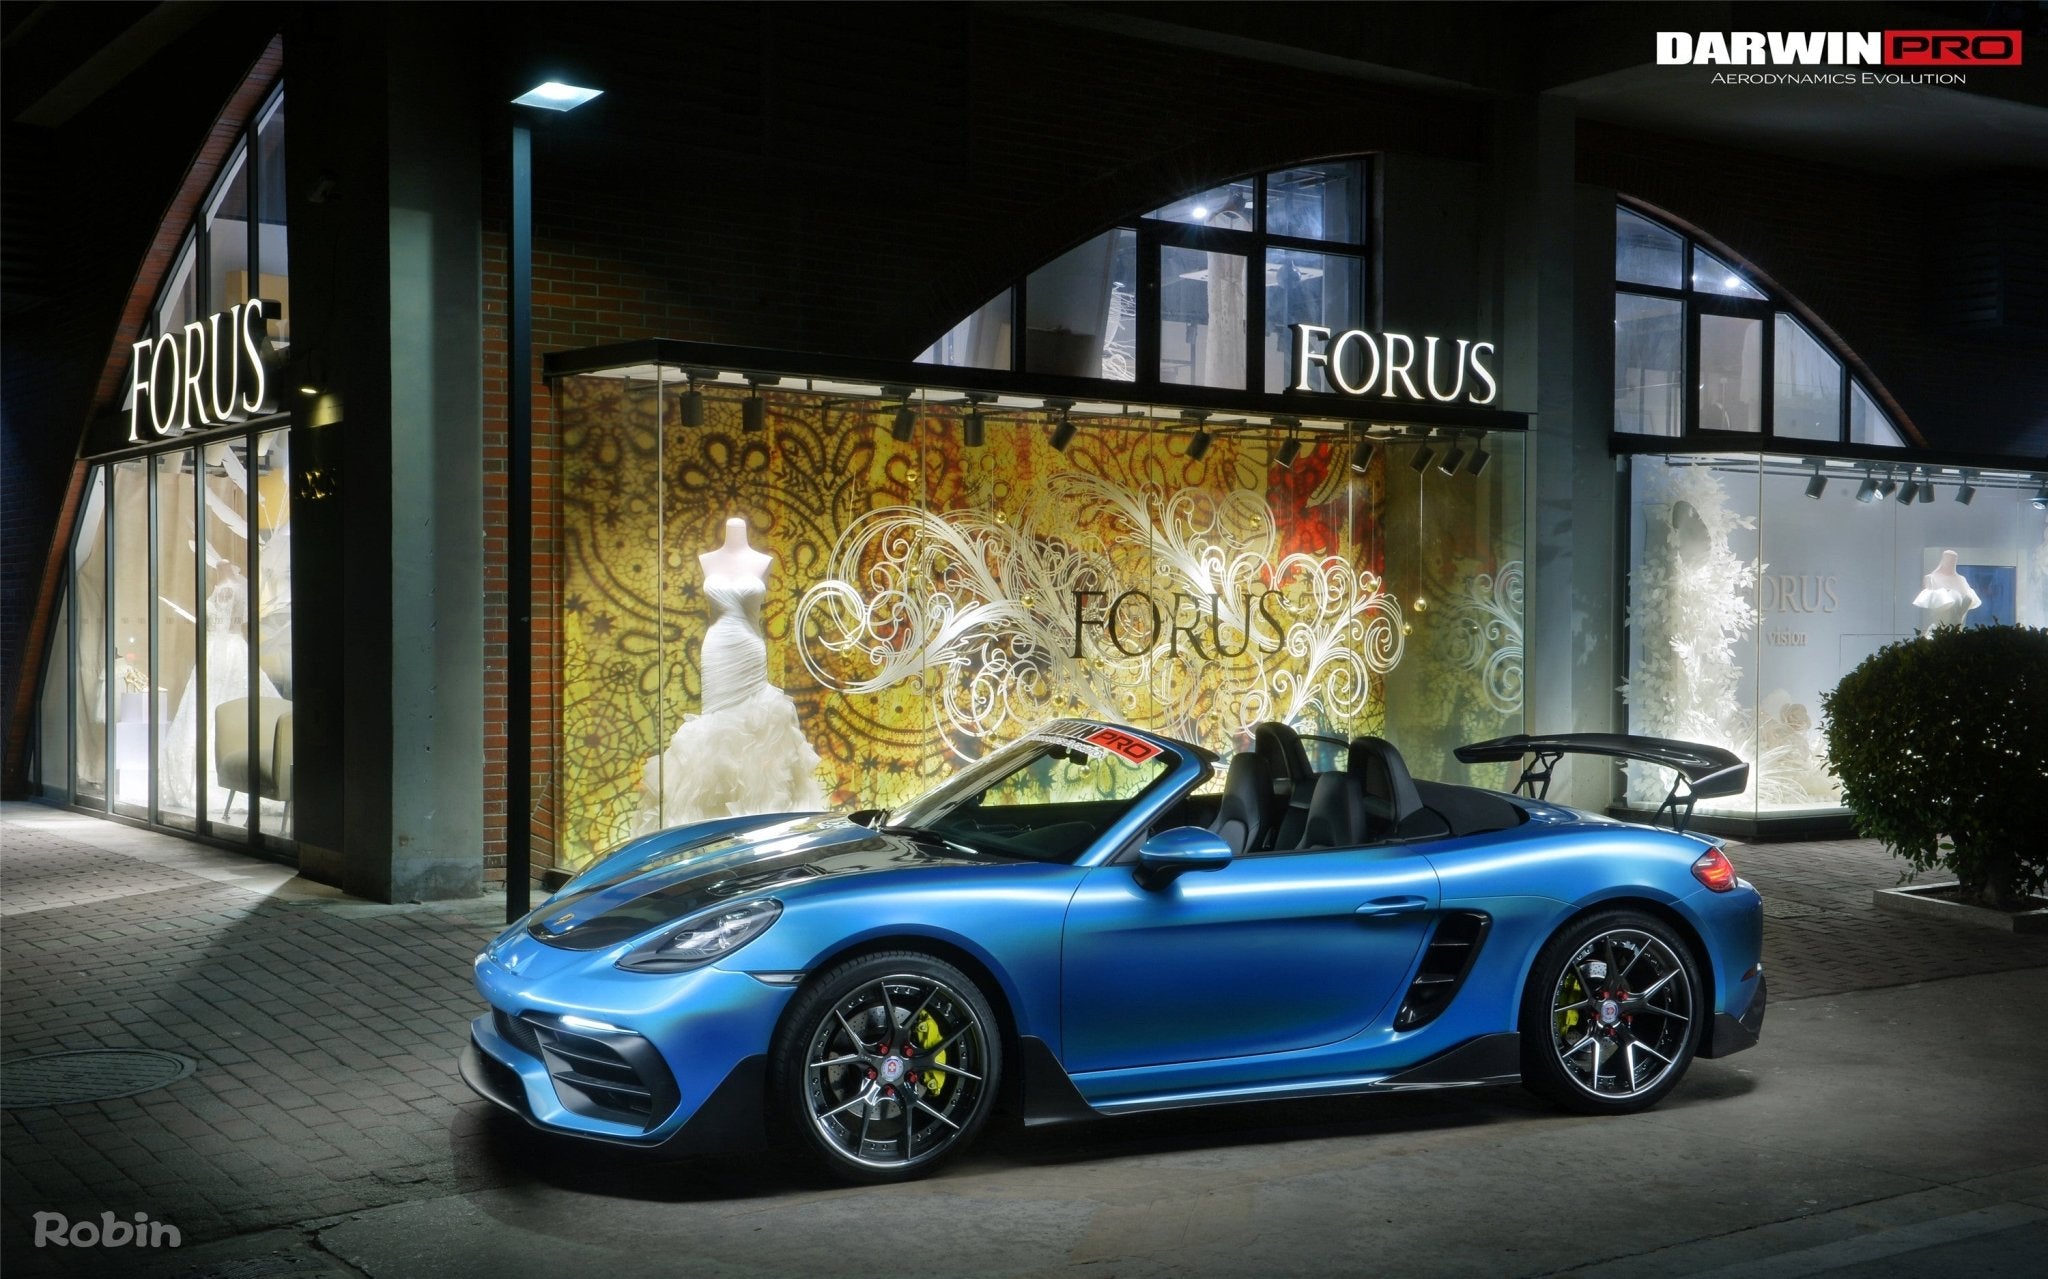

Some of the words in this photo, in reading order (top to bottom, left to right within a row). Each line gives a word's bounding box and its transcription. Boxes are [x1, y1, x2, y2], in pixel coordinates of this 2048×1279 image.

[128, 298, 265, 442] FORUS
[1294, 323, 1497, 405] FORUS
[1067, 589, 1286, 661] FORUS
[1742, 575, 1839, 613] ORUS
[1092, 730, 1152, 759] PRO
